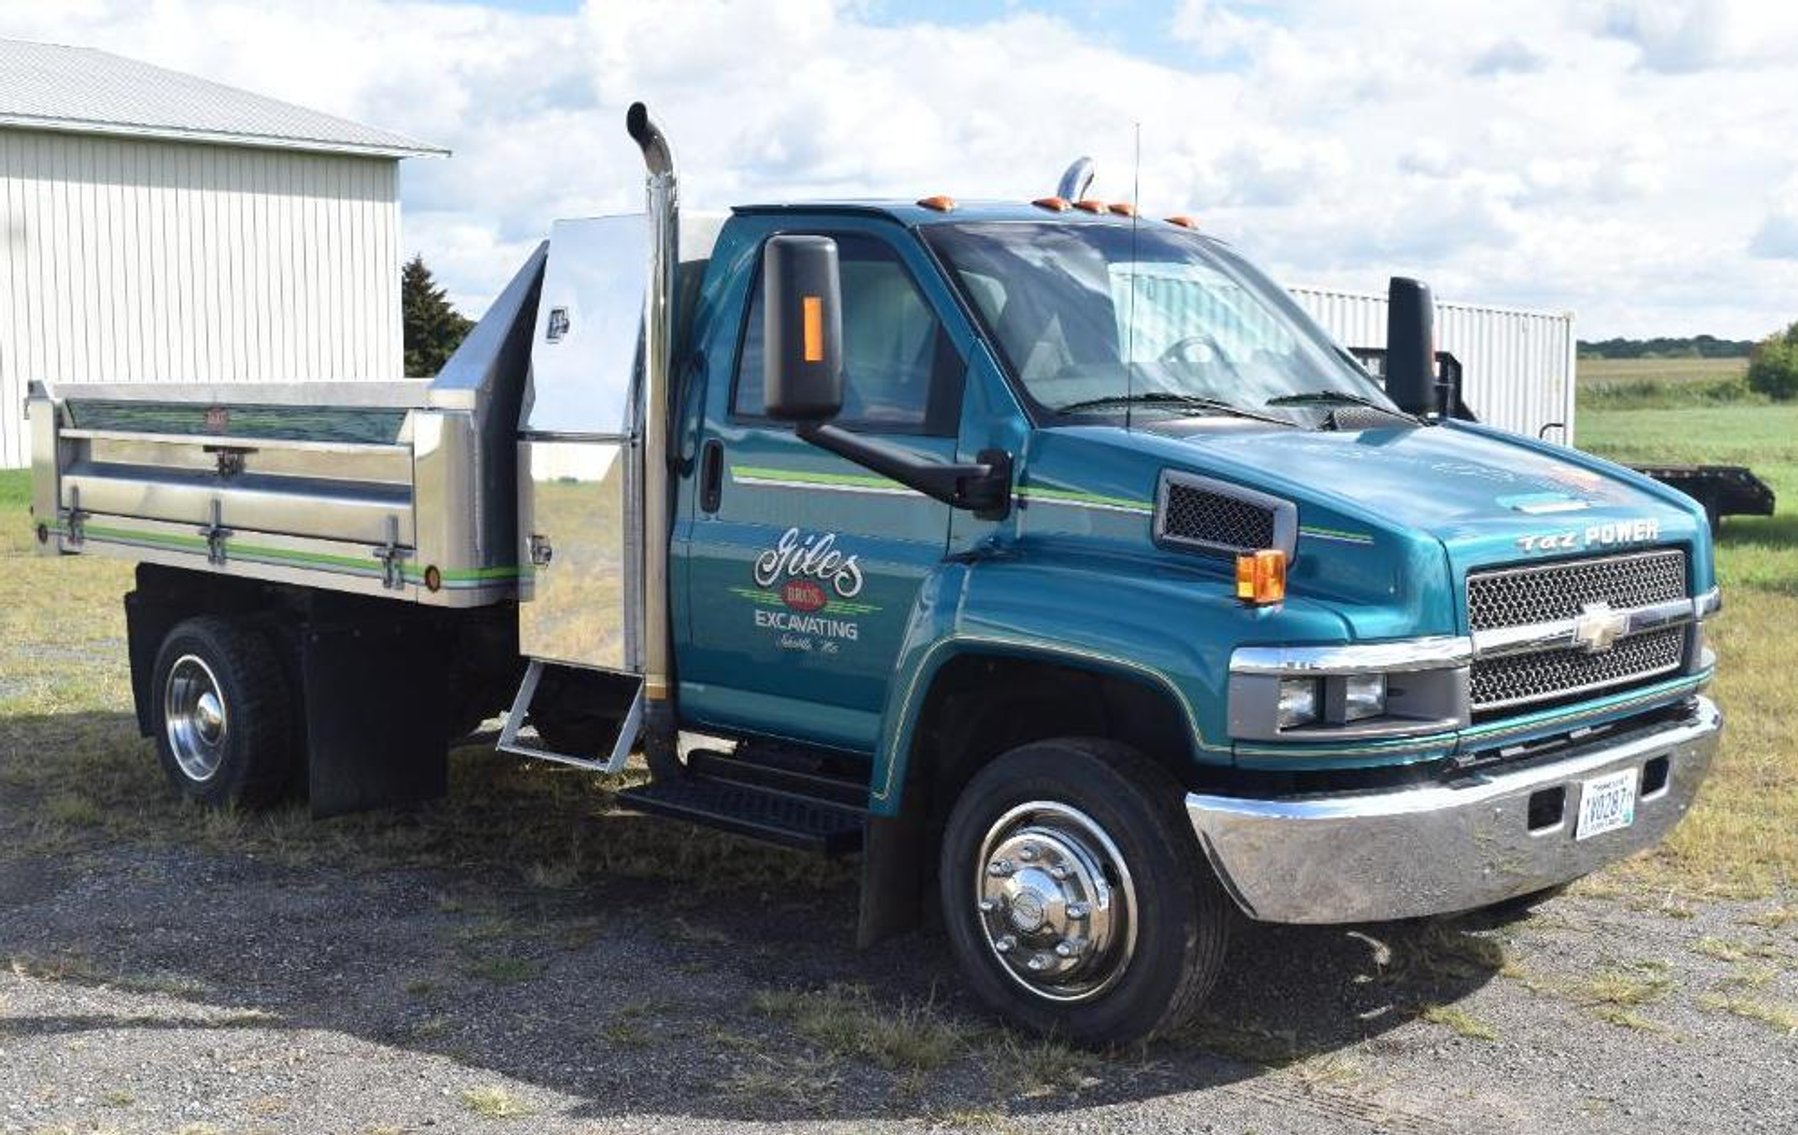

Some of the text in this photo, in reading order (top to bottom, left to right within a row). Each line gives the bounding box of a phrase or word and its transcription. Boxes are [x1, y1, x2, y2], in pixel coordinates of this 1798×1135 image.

[1585, 519, 1658, 546] POWER
[755, 527, 862, 597] Giles
[754, 608, 858, 640] EXCAVATING
